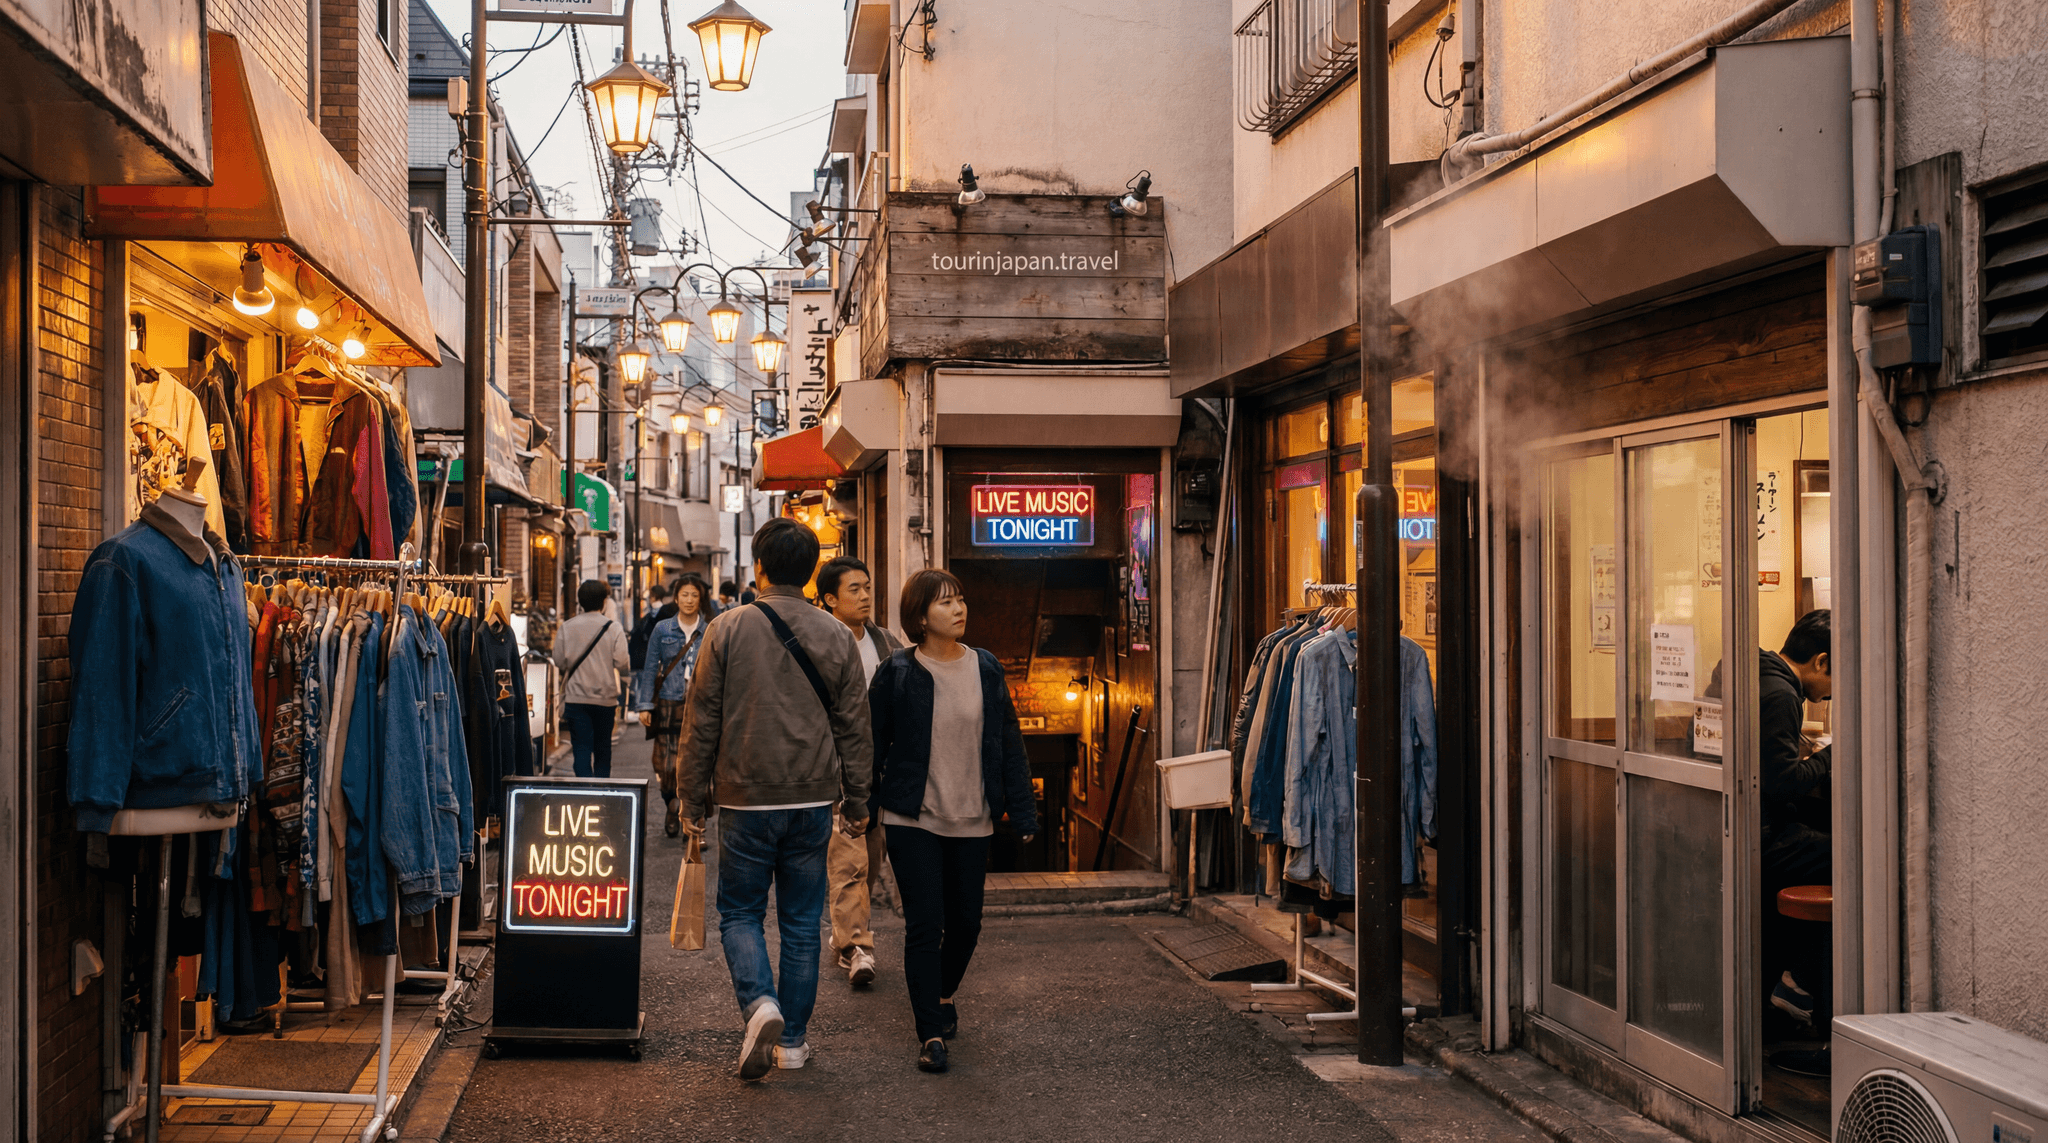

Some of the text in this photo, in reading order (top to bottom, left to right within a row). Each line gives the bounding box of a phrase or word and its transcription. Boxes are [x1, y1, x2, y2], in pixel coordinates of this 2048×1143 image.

[976, 491, 1089, 514] LIVE MUSIC
[986, 518, 1079, 541] TONIGHT
[544, 804, 601, 838] LIVE
[528, 843, 615, 878] MUSIC
[512, 883, 628, 919] TONIGHT
